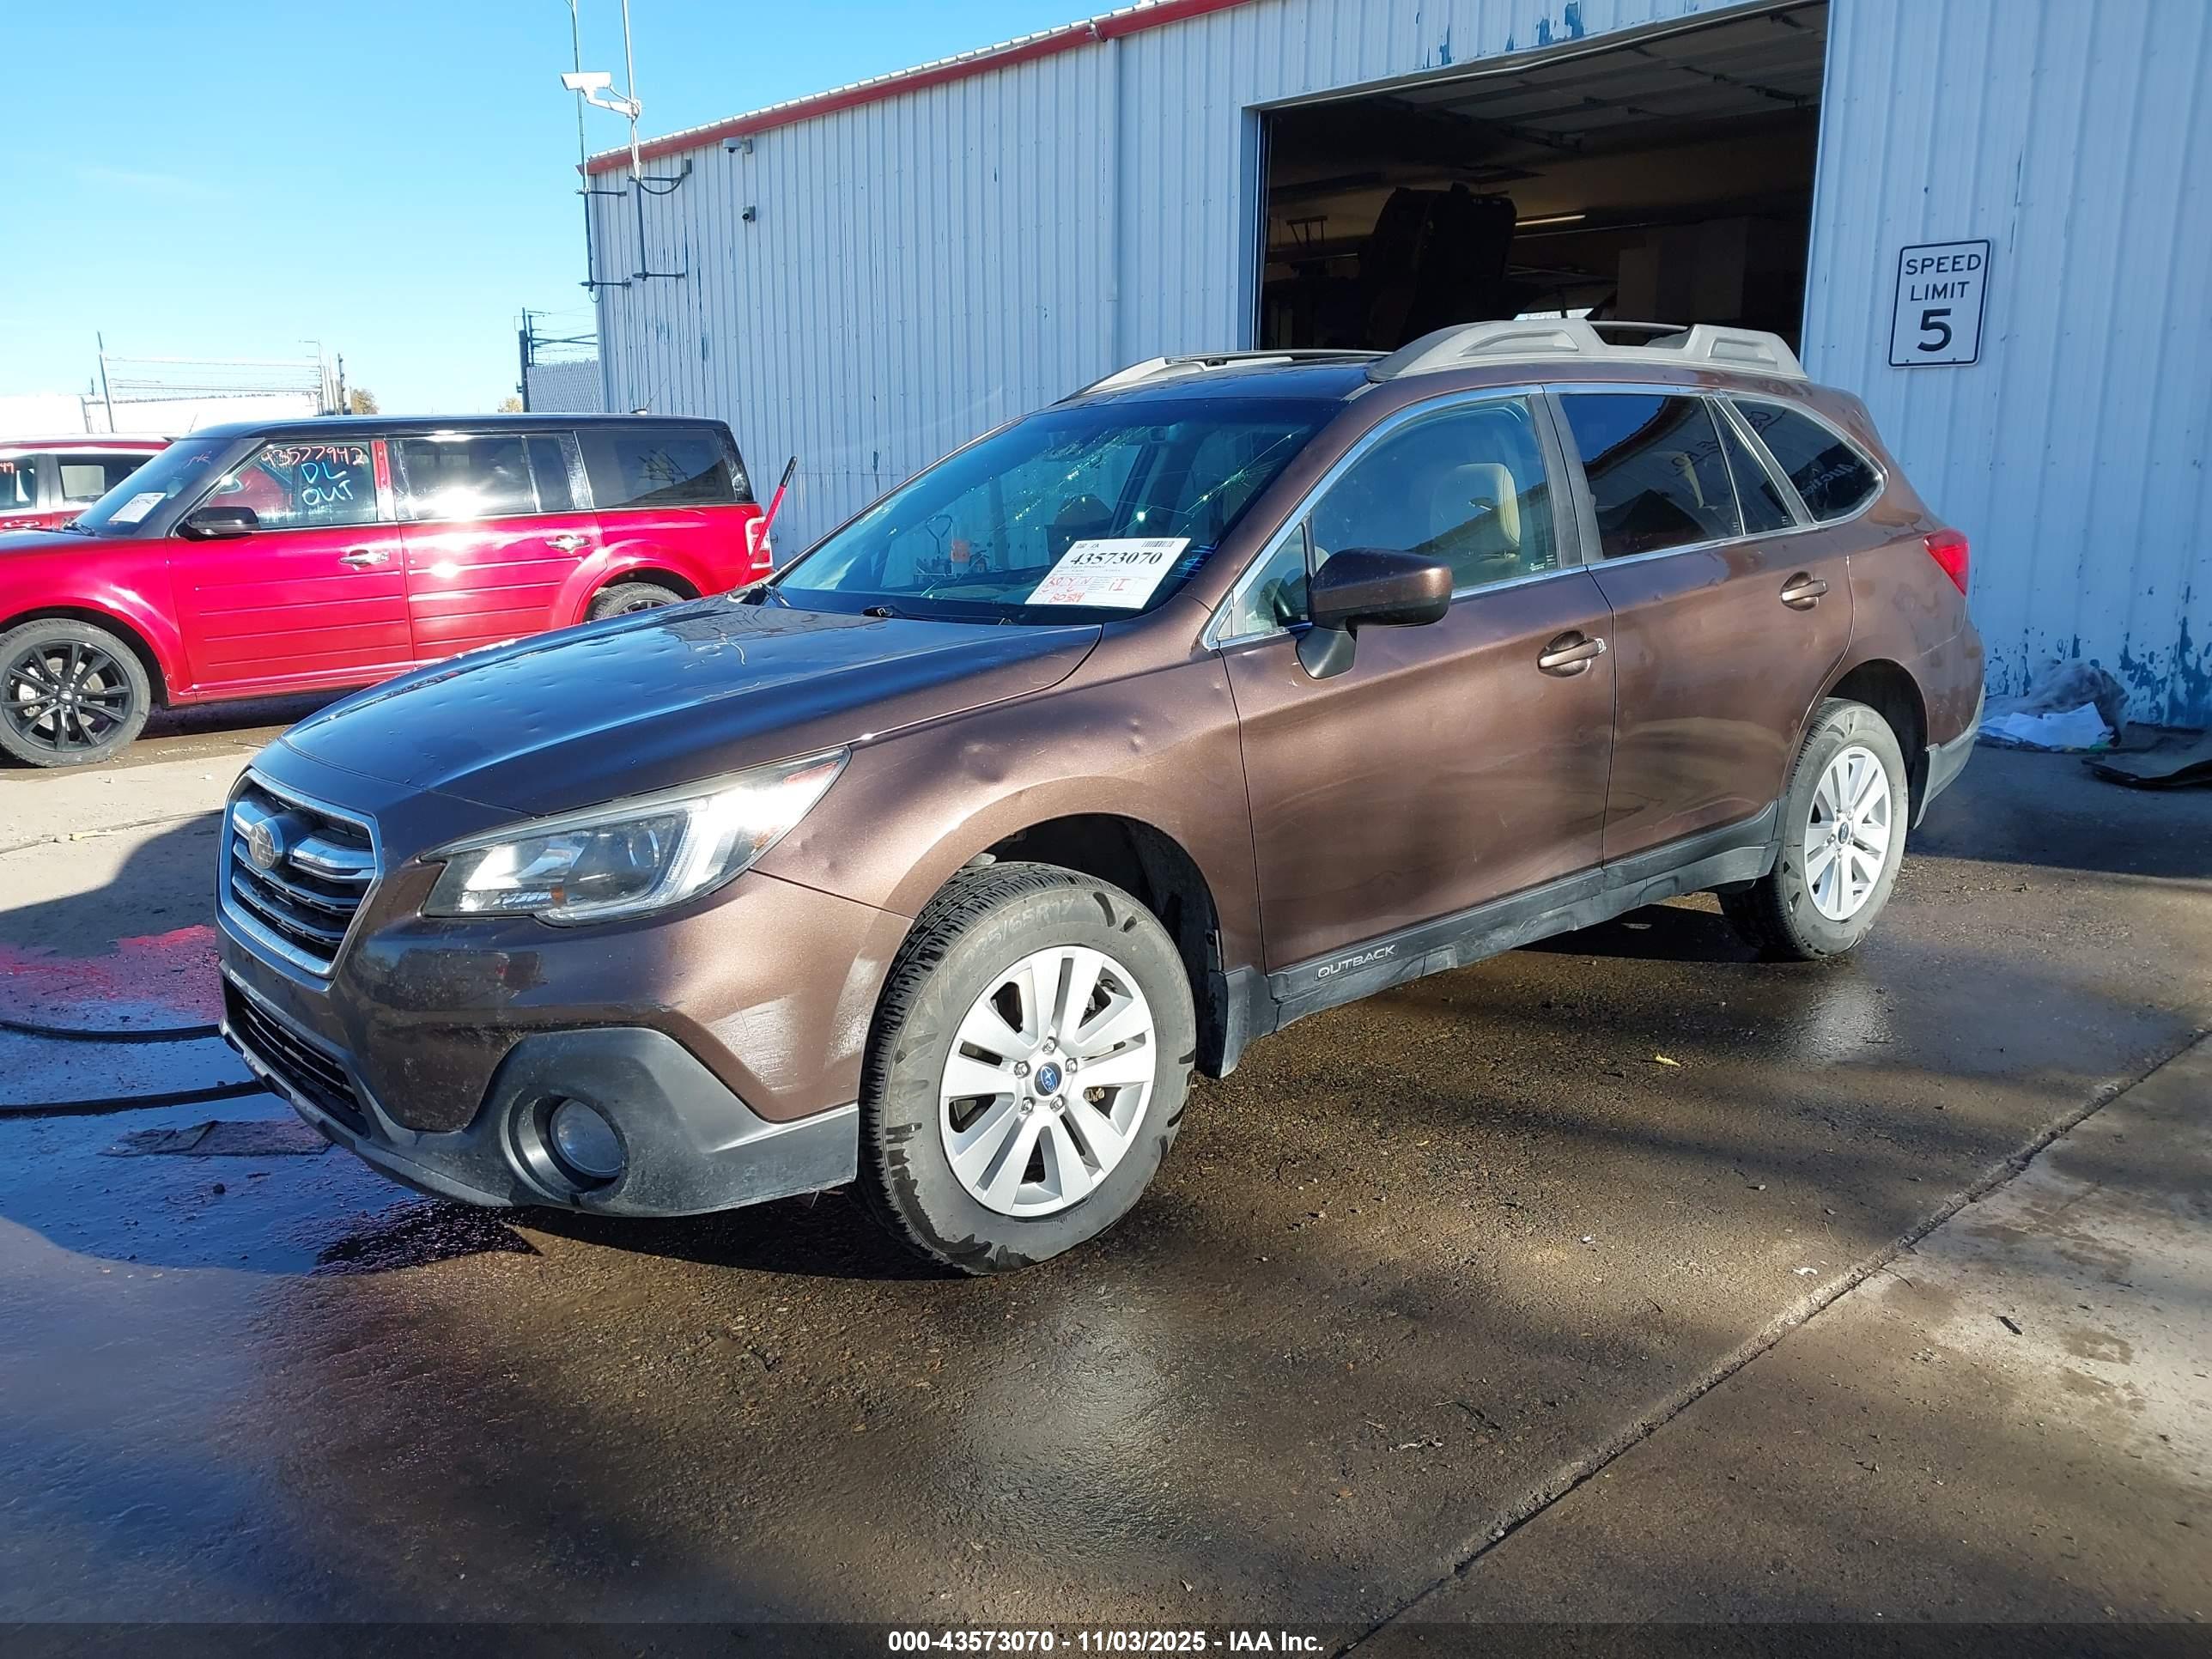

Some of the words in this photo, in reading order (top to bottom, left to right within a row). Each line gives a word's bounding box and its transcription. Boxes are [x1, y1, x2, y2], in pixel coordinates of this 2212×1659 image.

[1905, 253, 1982, 276] SPEED
[1910, 281, 1971, 302] LIMIT
[1917, 307, 1953, 352] 5
[260, 446, 365, 467] 43577942
[301, 462, 347, 483] DL
[301, 479, 354, 506] OUT
[1070, 551, 1164, 565] 43573070
[1317, 944, 1395, 979] OUTBACK
